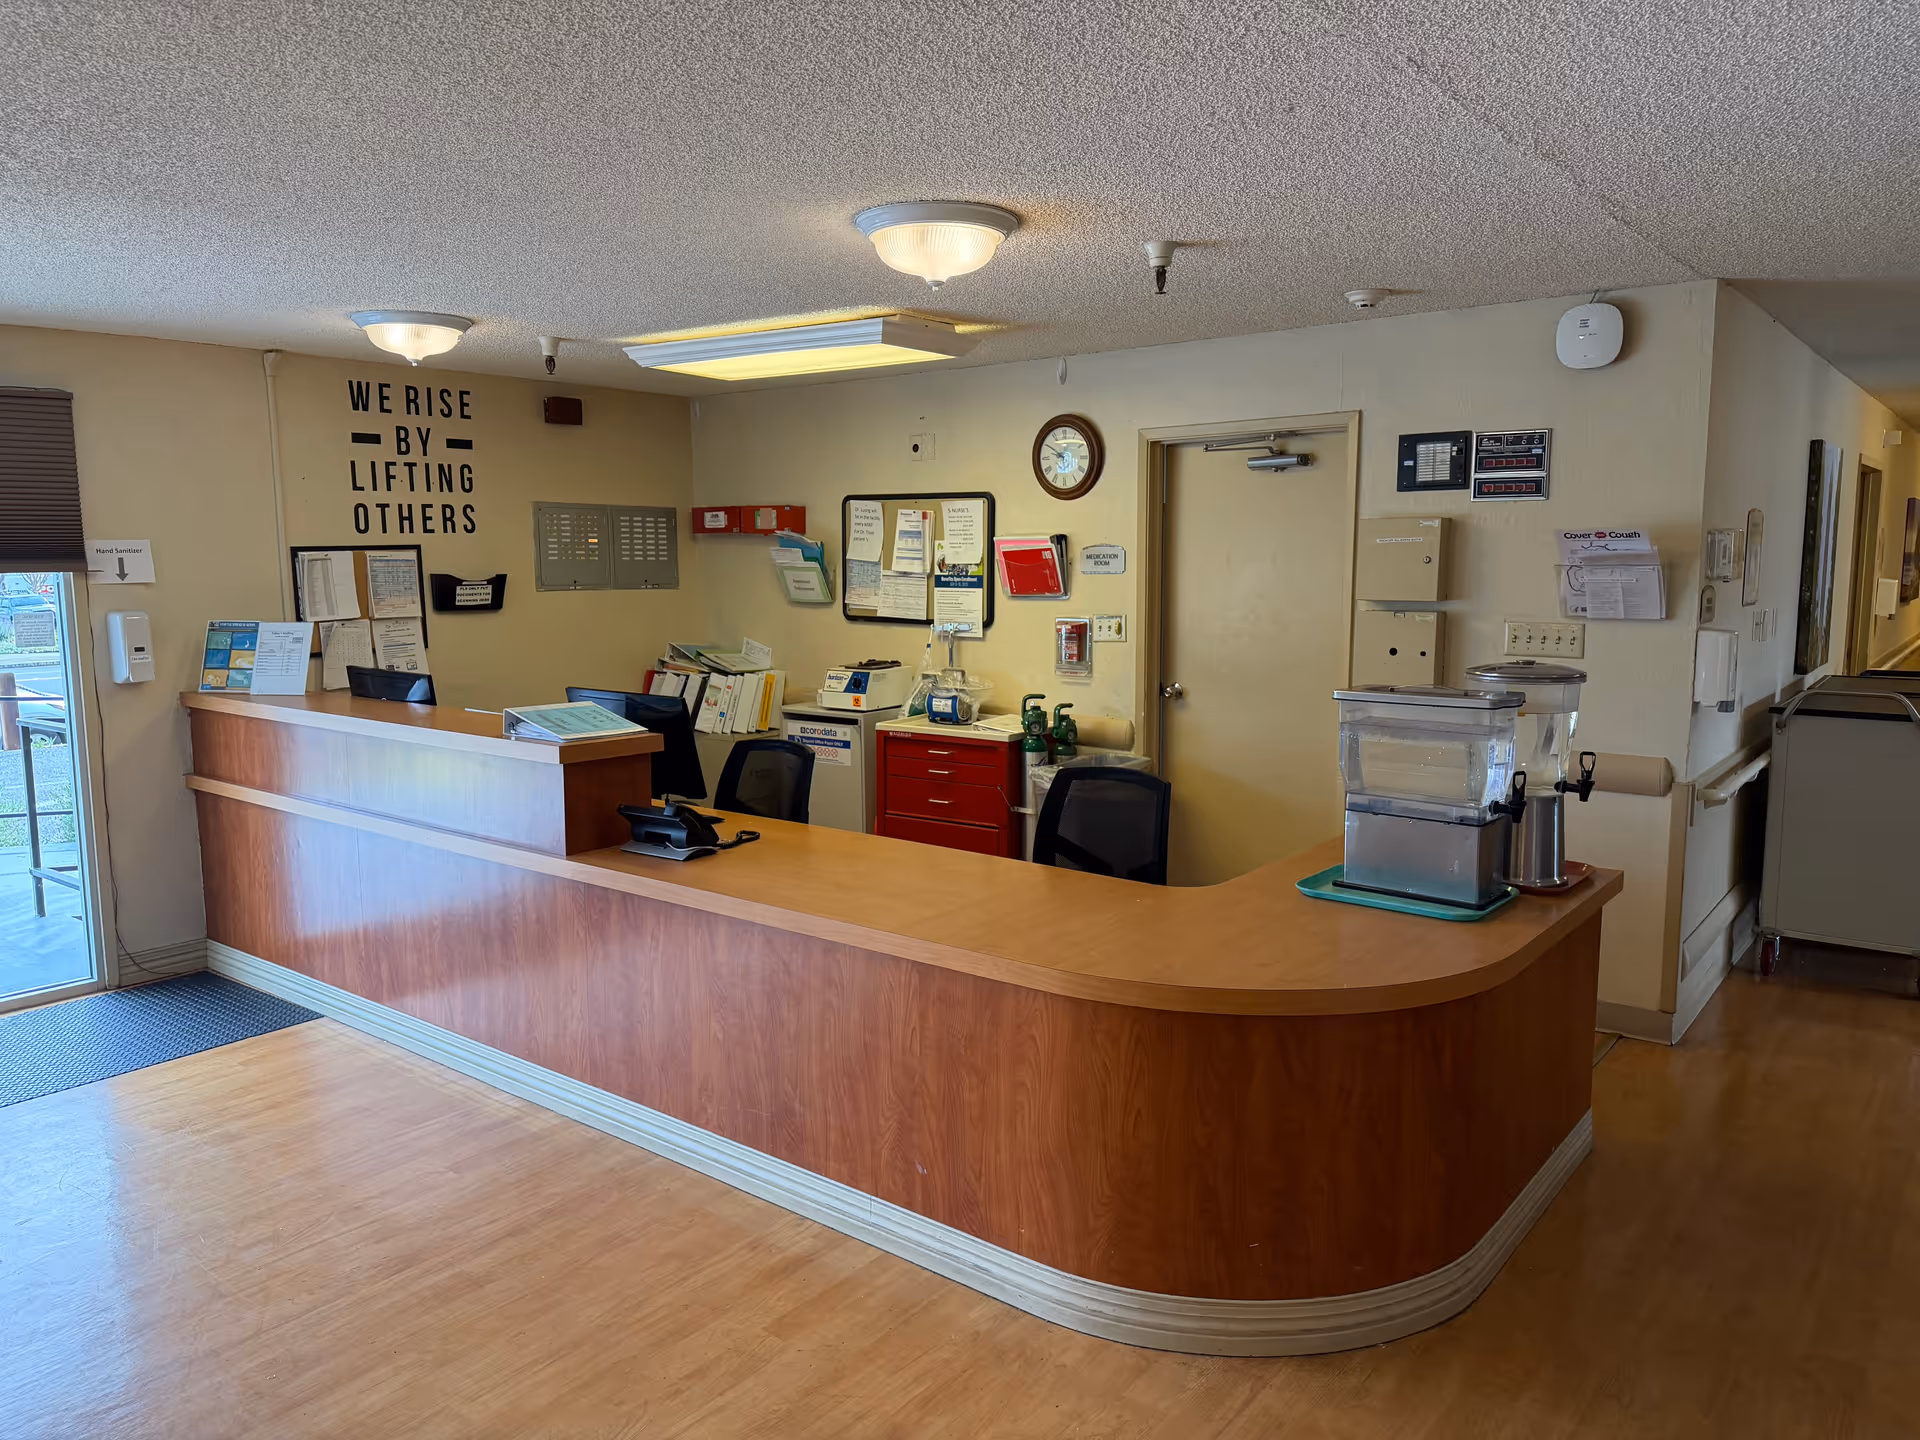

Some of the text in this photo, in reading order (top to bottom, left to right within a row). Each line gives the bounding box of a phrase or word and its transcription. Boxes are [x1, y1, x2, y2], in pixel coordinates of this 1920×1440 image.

[348, 380, 472, 420] WE RISE
[395, 425, 431, 457] BY
[350, 460, 474, 494] LIFTING
[354, 502, 476, 534] OTHERS
[1563, 532, 1592, 540] Cover
[1608, 531, 1641, 539] Cough
[804, 726, 837, 737] corodata
